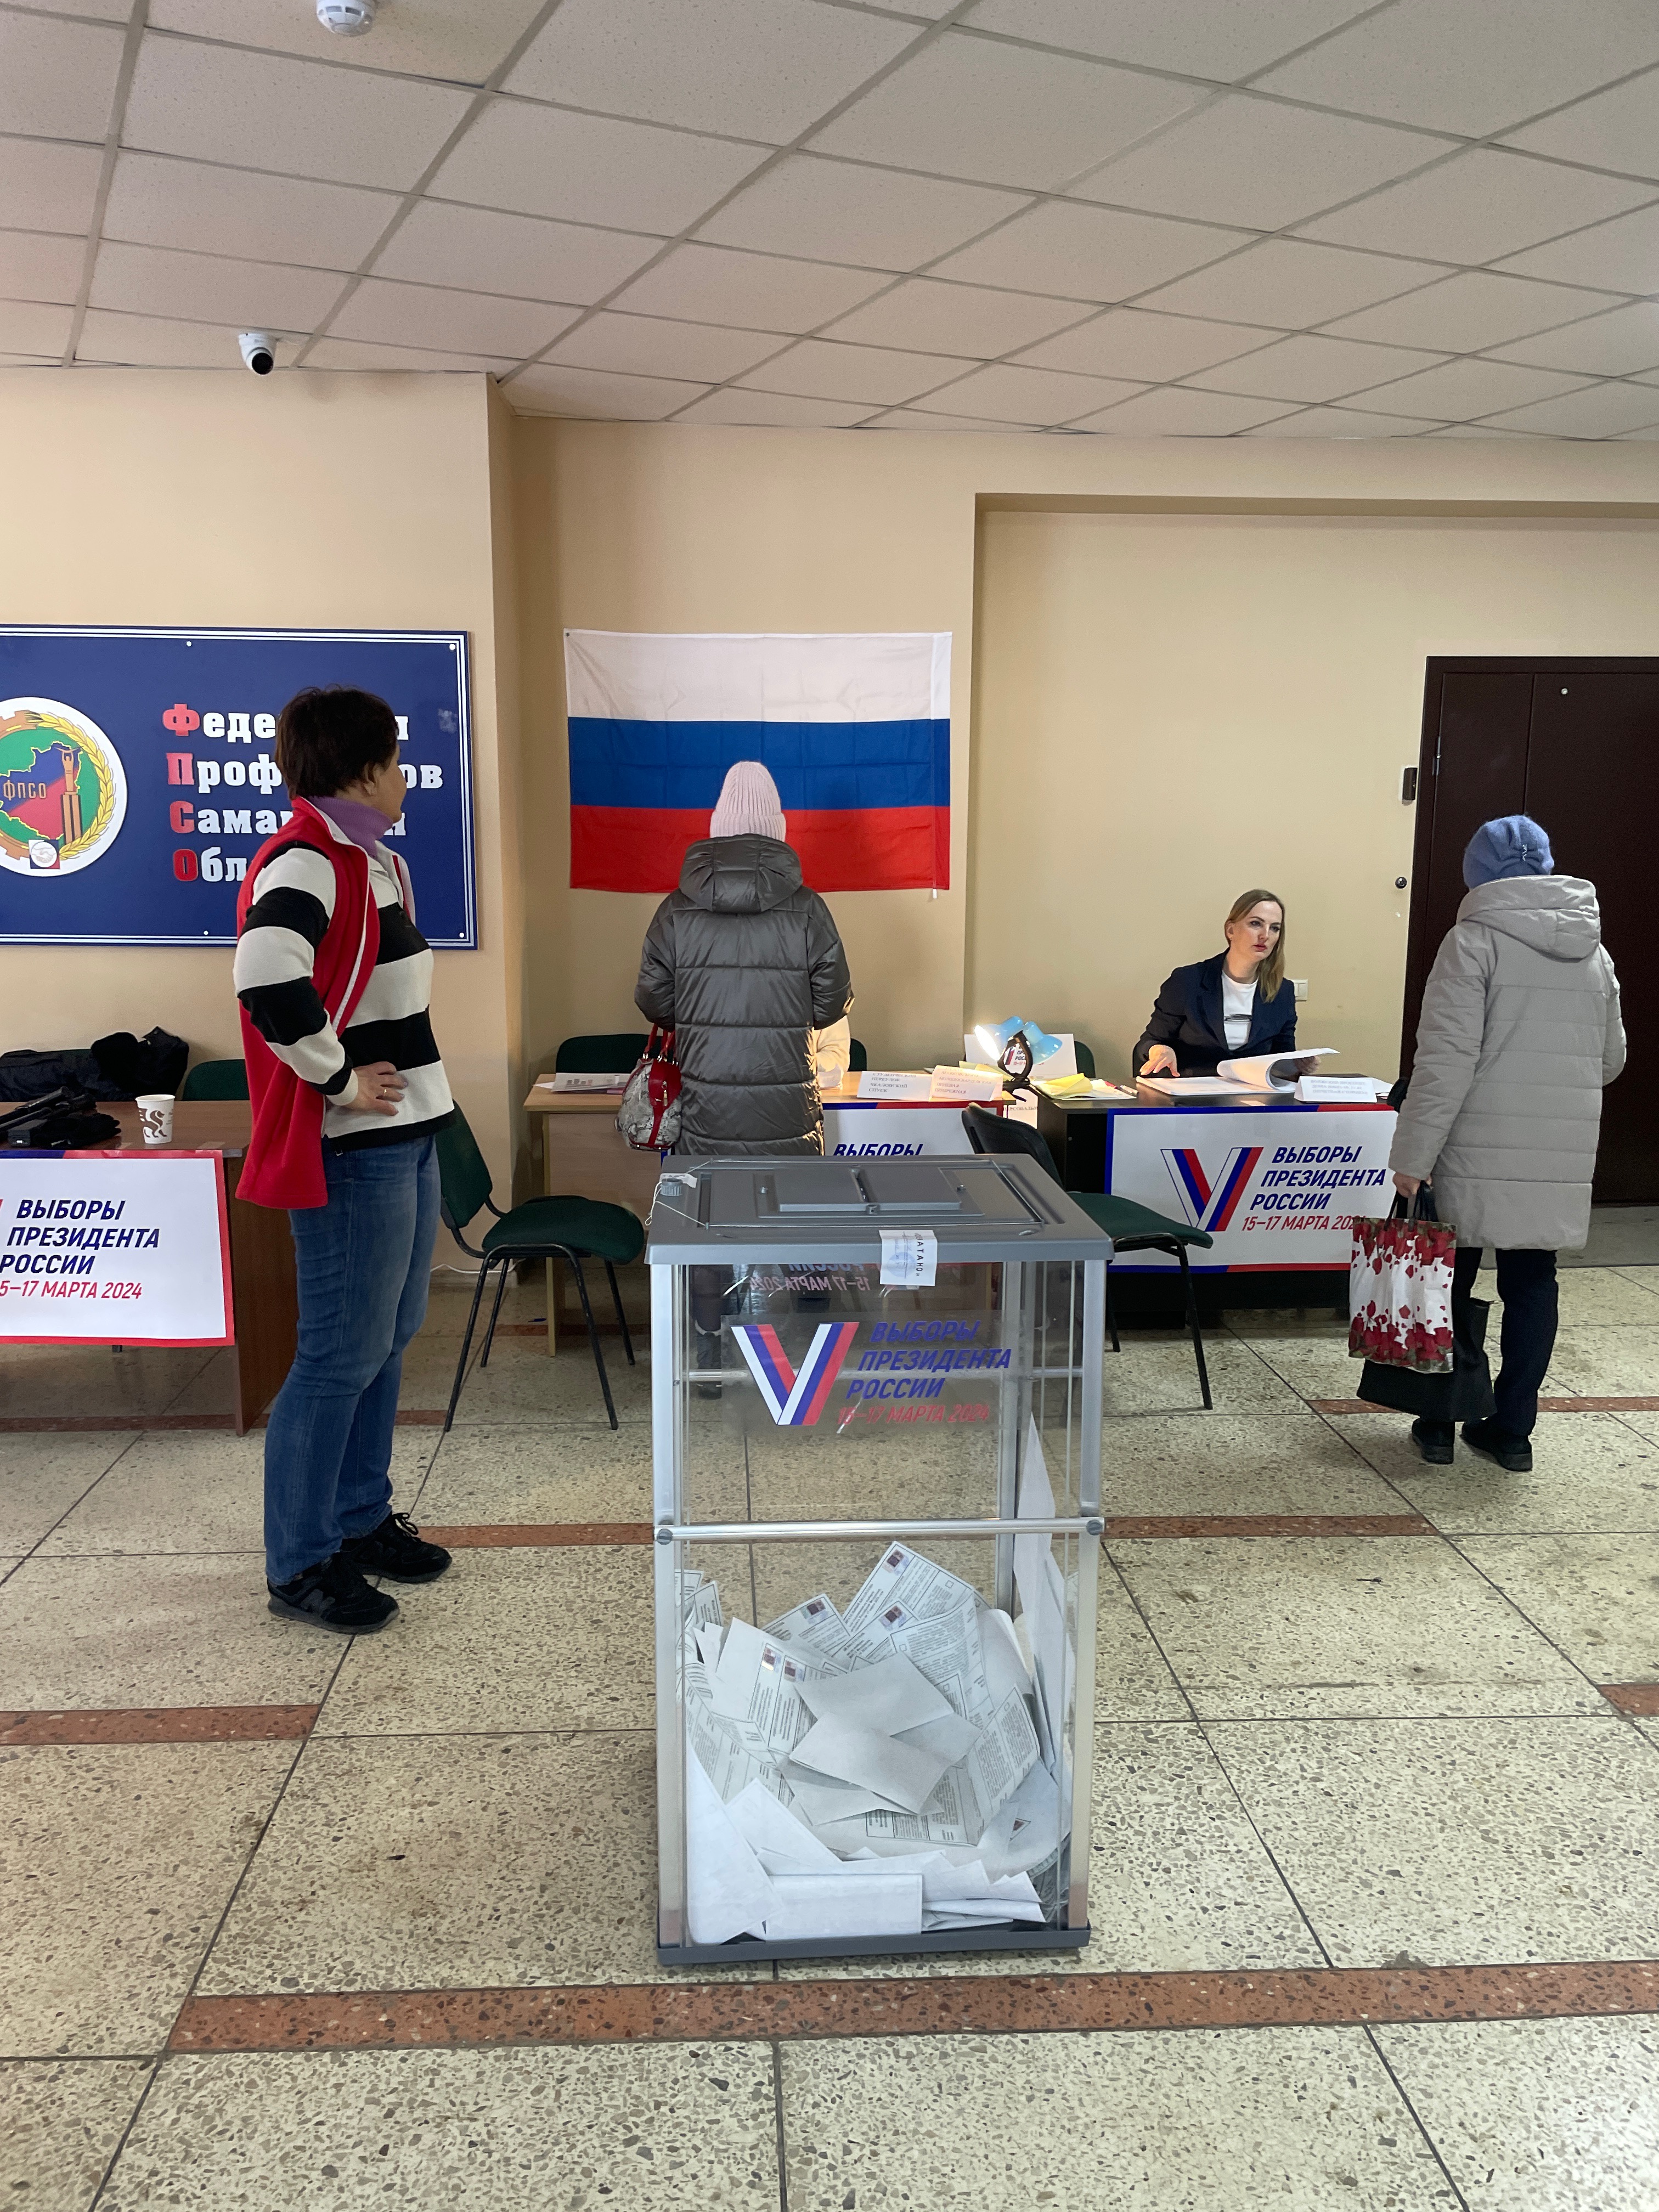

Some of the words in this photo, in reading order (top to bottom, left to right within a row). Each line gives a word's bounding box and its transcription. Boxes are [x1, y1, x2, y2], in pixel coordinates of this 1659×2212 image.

[166, 753, 443, 794] Профов
[3, 780, 47, 800] ФПСО
[1272, 1146, 1363, 1163] ВЫБОРЫ
[1260, 1169, 1386, 1189] ПРЕЗИДЕНТА
[16, 1199, 126, 1220] ВЫБОРЫ
[1250, 1193, 1332, 1210] РОССИИ
[1281, 1215, 1330, 1231] МАРТА
[7, 1227, 160, 1250] ПРЕЗИДЕНТА
[0, 1254, 95, 1274] РОССИИ
[41, 1280, 98, 1299] МАРТА
[101, 1282, 142, 1299] 2024
[869, 1319, 981, 1343] ВЫБОРЫ
[857, 1348, 1012, 1373] ПРЕЗИДЕНТА
[845, 1378, 946, 1400] РОССИИ
[885, 1404, 946, 1424] МАРТА
[947, 1403, 990, 1423] 2024
